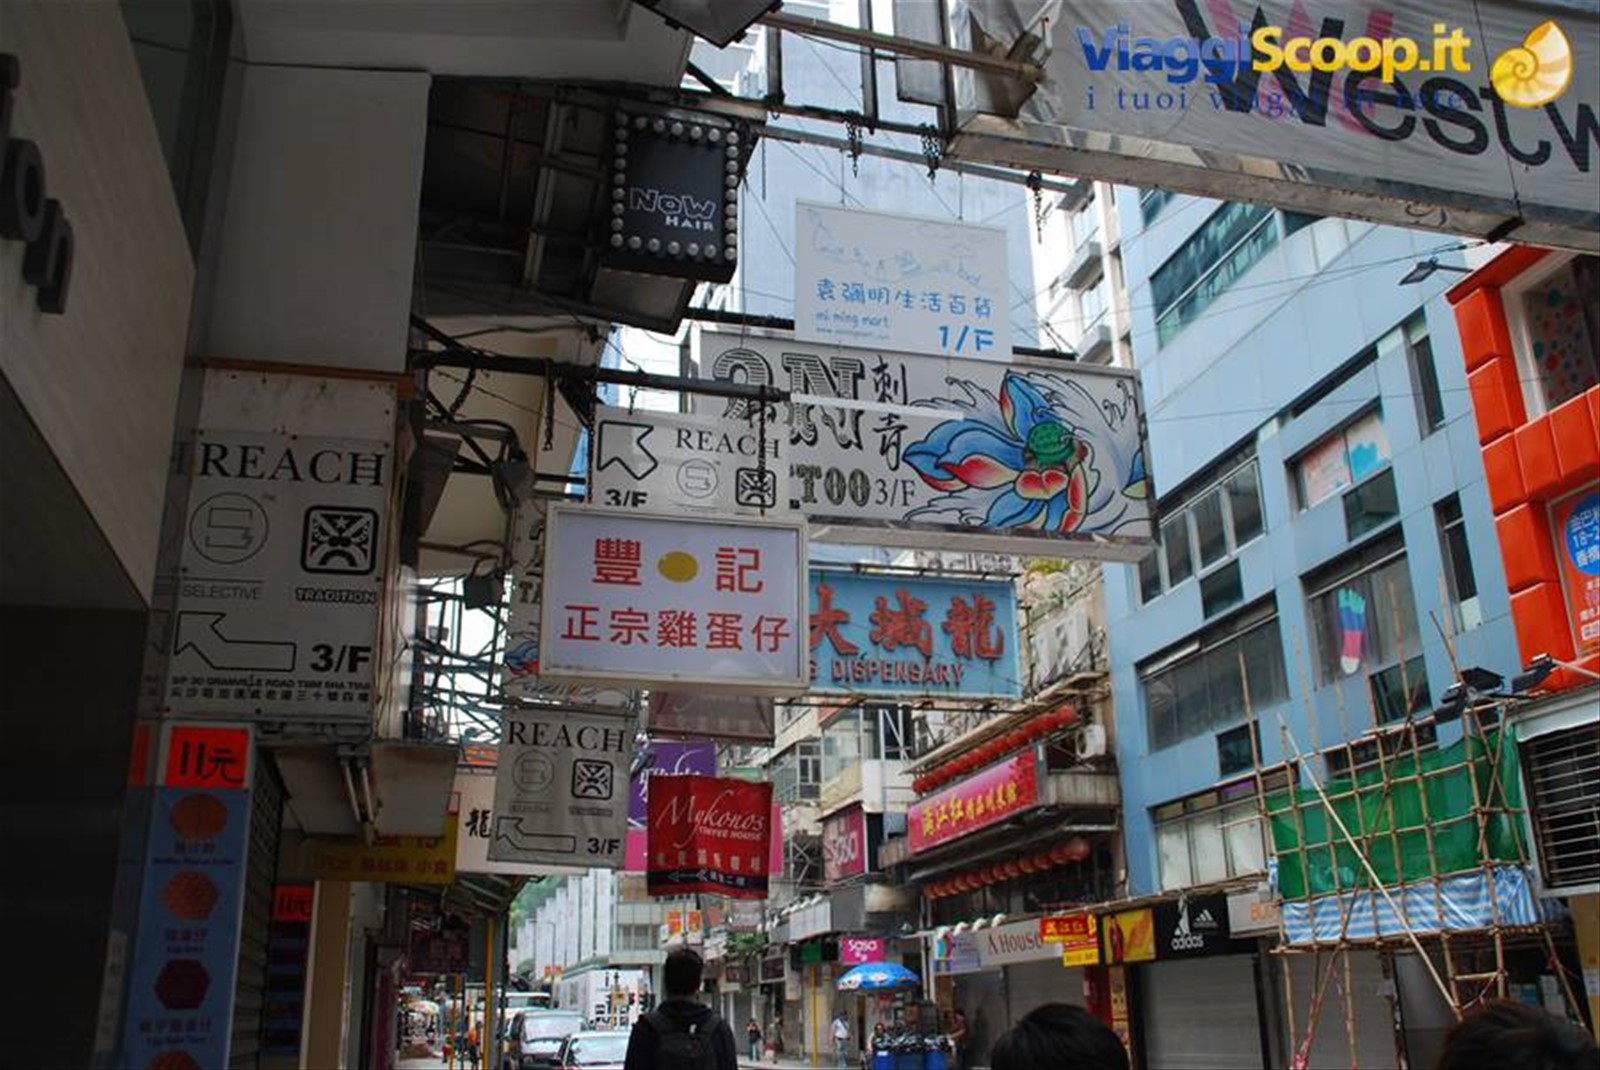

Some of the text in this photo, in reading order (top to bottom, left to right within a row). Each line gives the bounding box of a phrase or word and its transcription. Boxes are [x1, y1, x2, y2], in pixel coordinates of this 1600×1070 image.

[665, 215, 714, 231] HAIR
[938, 325, 995, 352] 1/F
[675, 428, 780, 460] REACH
[198, 442, 387, 487] REACH
[604, 488, 648, 508] 3/F
[875, 477, 917, 507] 3/F
[183, 584, 264, 601] SELECTIVE
[295, 587, 377, 605] TRADITION
[561, 604, 790, 653] 正宗雞蛋仔
[309, 643, 372, 673] 3/F
[205, 676, 263, 688] GRANVILLE
[265, 678, 294, 688] ROAD
[831, 659, 966, 686] DISPENSARY
[508, 720, 626, 753] REACH
[178, 740, 244, 784] 11元
[655, 789, 766, 849] Mykonos
[587, 837, 621, 856] 3/F
[730, 830, 763, 842] HOUSE
[1171, 933, 1205, 951] adidas
